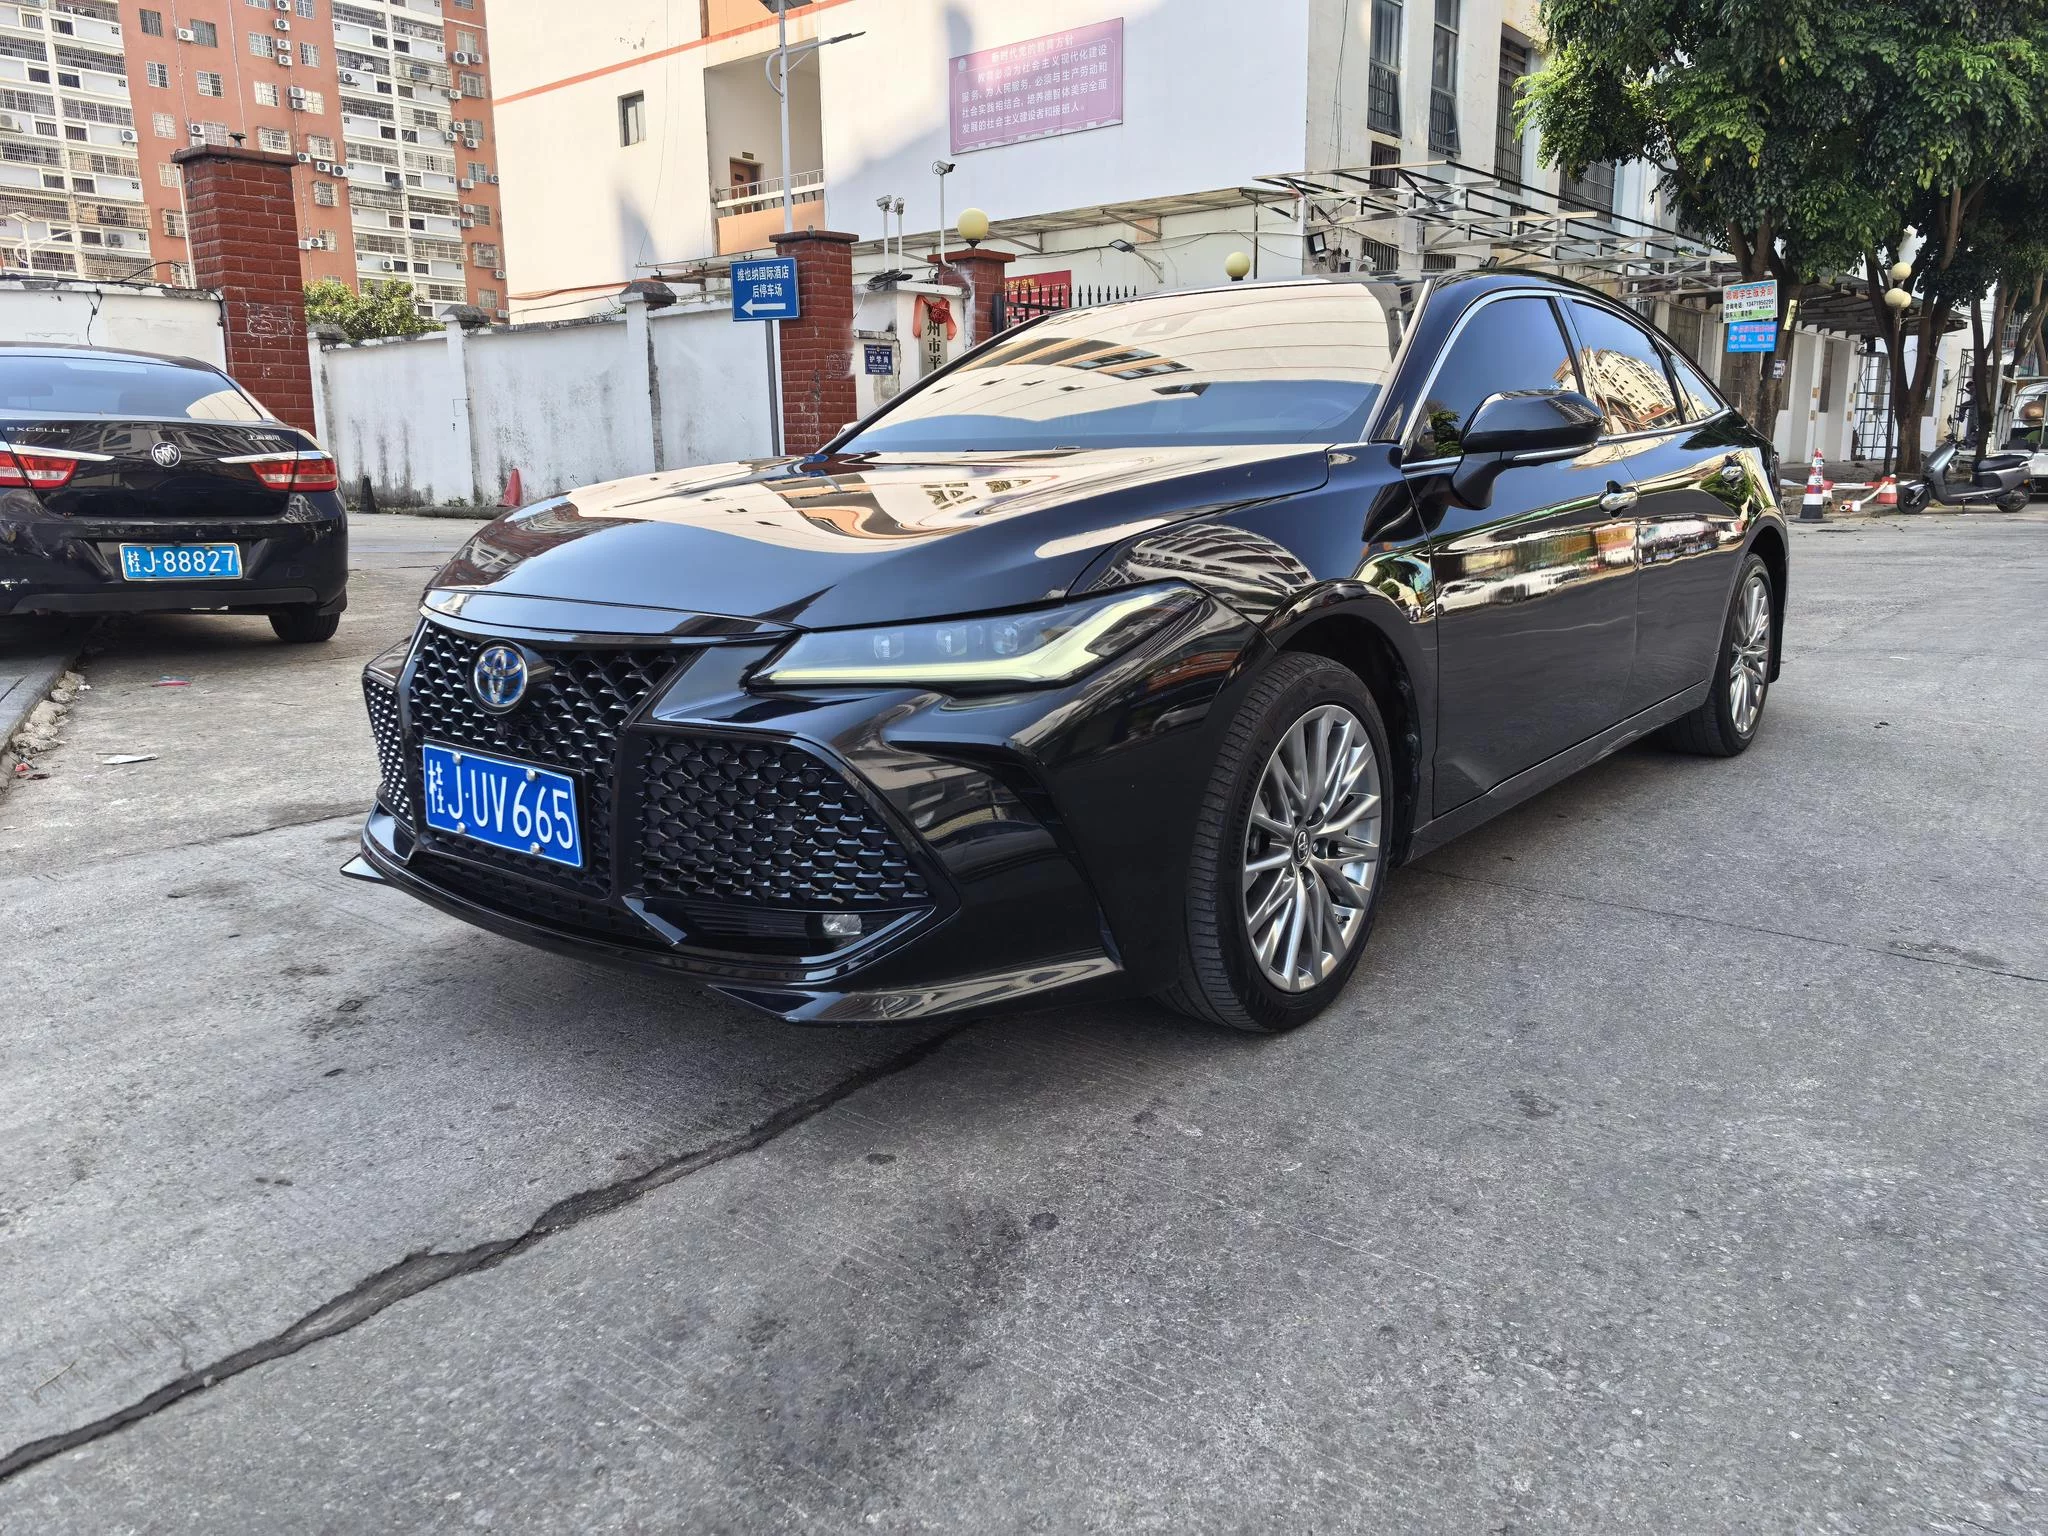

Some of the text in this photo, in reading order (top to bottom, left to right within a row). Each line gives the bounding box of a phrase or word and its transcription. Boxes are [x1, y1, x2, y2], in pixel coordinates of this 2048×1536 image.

[991, 34, 1074, 64] 新时代党的教育方针
[977, 44, 1107, 84] 教育必须为社会主义现代化建设
[737, 265, 789, 282] 维也纳国际酒店
[752, 283, 783, 298] 后停车场
[927, 320, 942, 373] 州市平
[6, 426, 71, 434] EXCELLE
